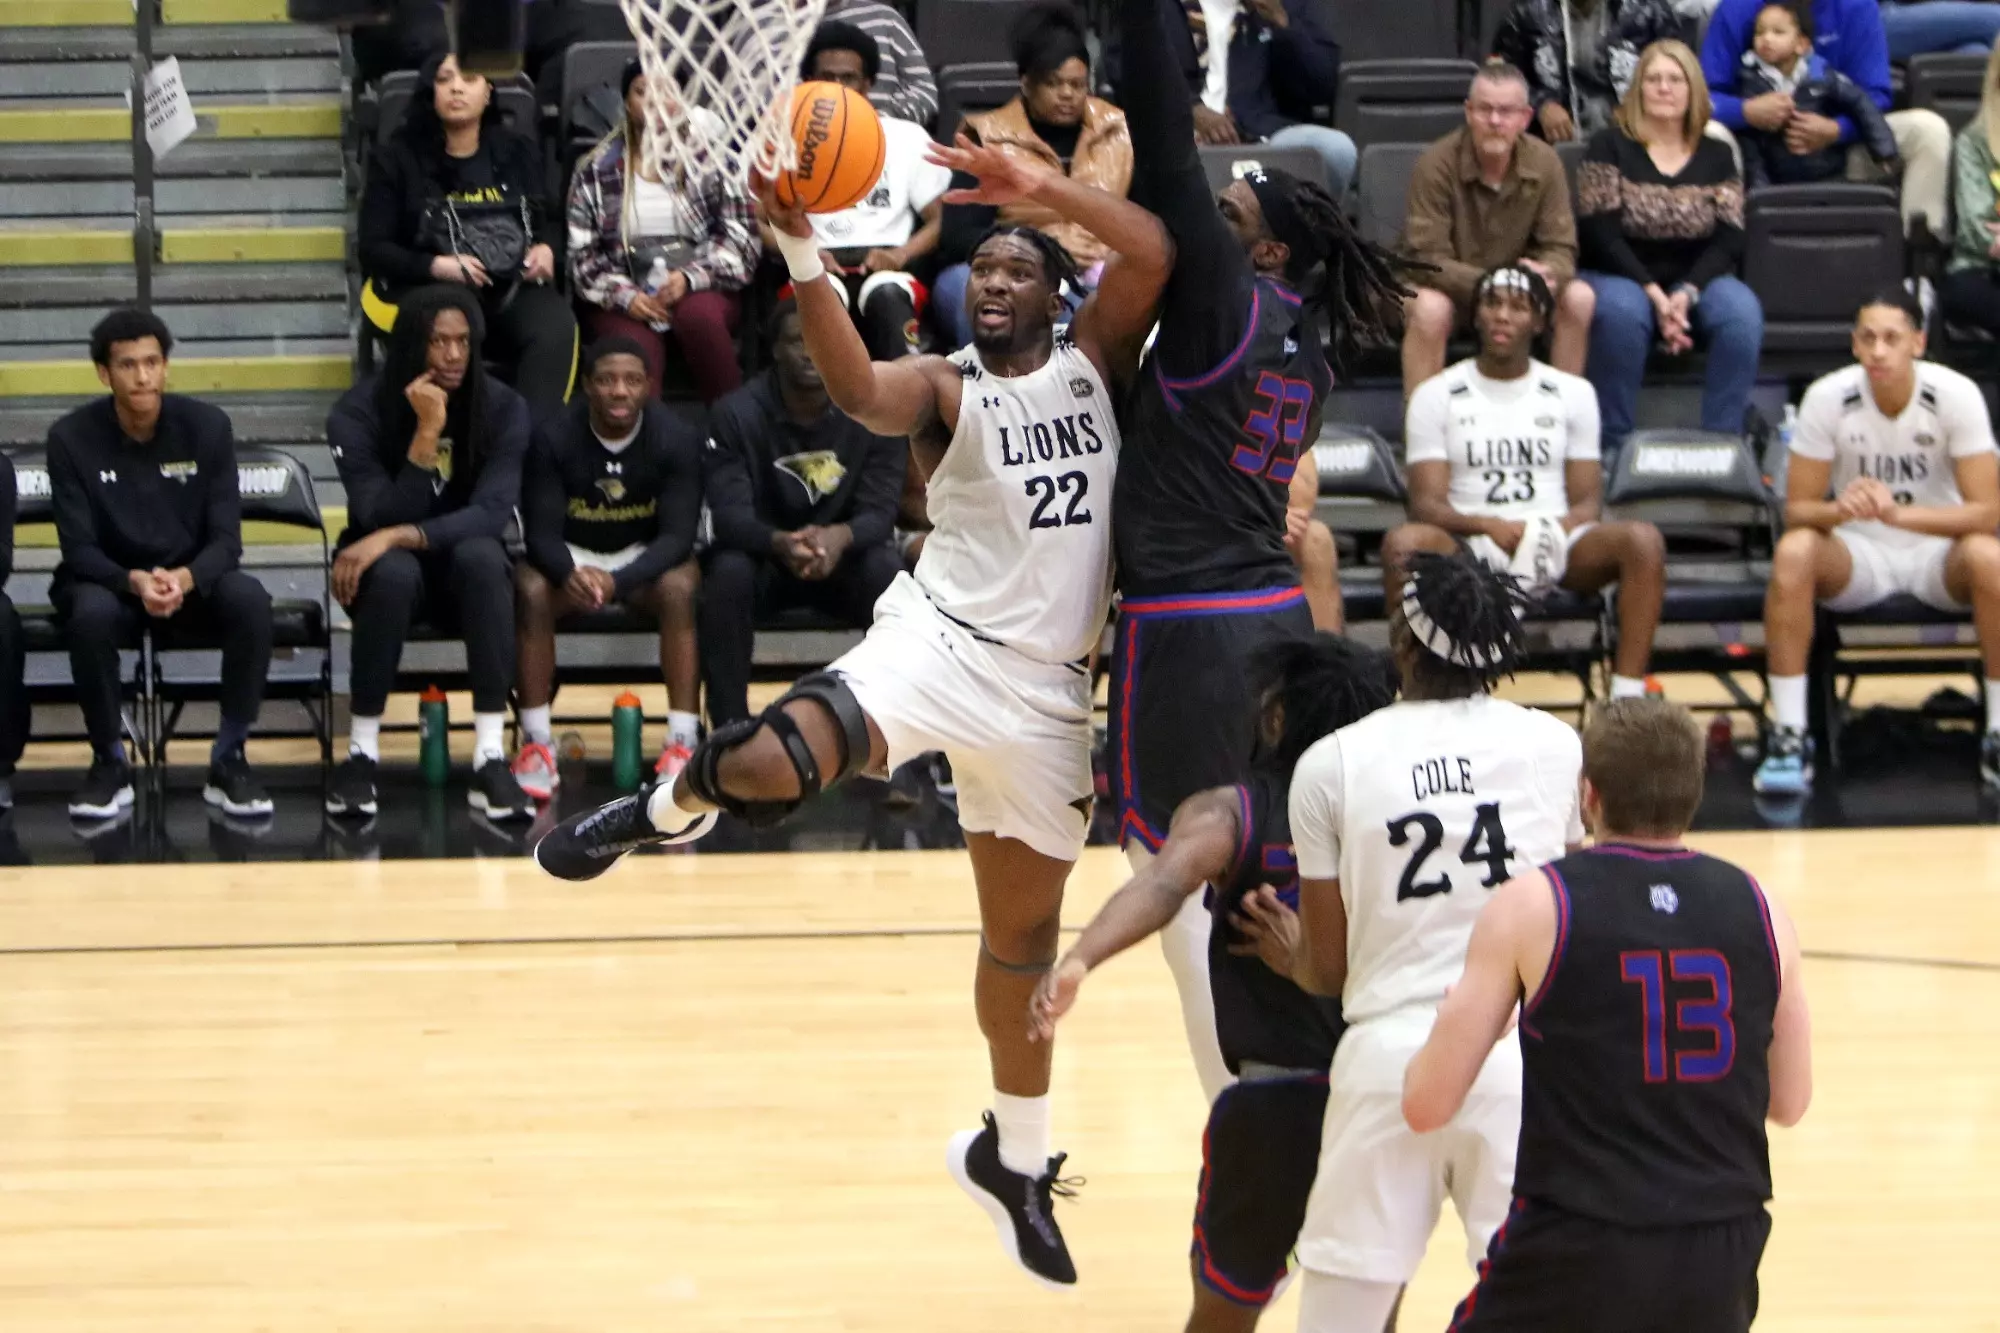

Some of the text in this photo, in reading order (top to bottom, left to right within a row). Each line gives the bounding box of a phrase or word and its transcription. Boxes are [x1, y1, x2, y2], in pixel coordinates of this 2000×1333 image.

[797, 98, 836, 180] Wilson
[999, 411, 1103, 466] LIONS
[1229, 370, 1314, 484] 33
[1466, 436, 1551, 468] LIONS
[1482, 469, 1535, 504] 23
[1859, 452, 1929, 484] LIONS
[1024, 470, 1093, 530] 22
[1412, 756, 1475, 801] COLE
[1386, 800, 1516, 904] 24
[1620, 949, 1736, 1083] 13
